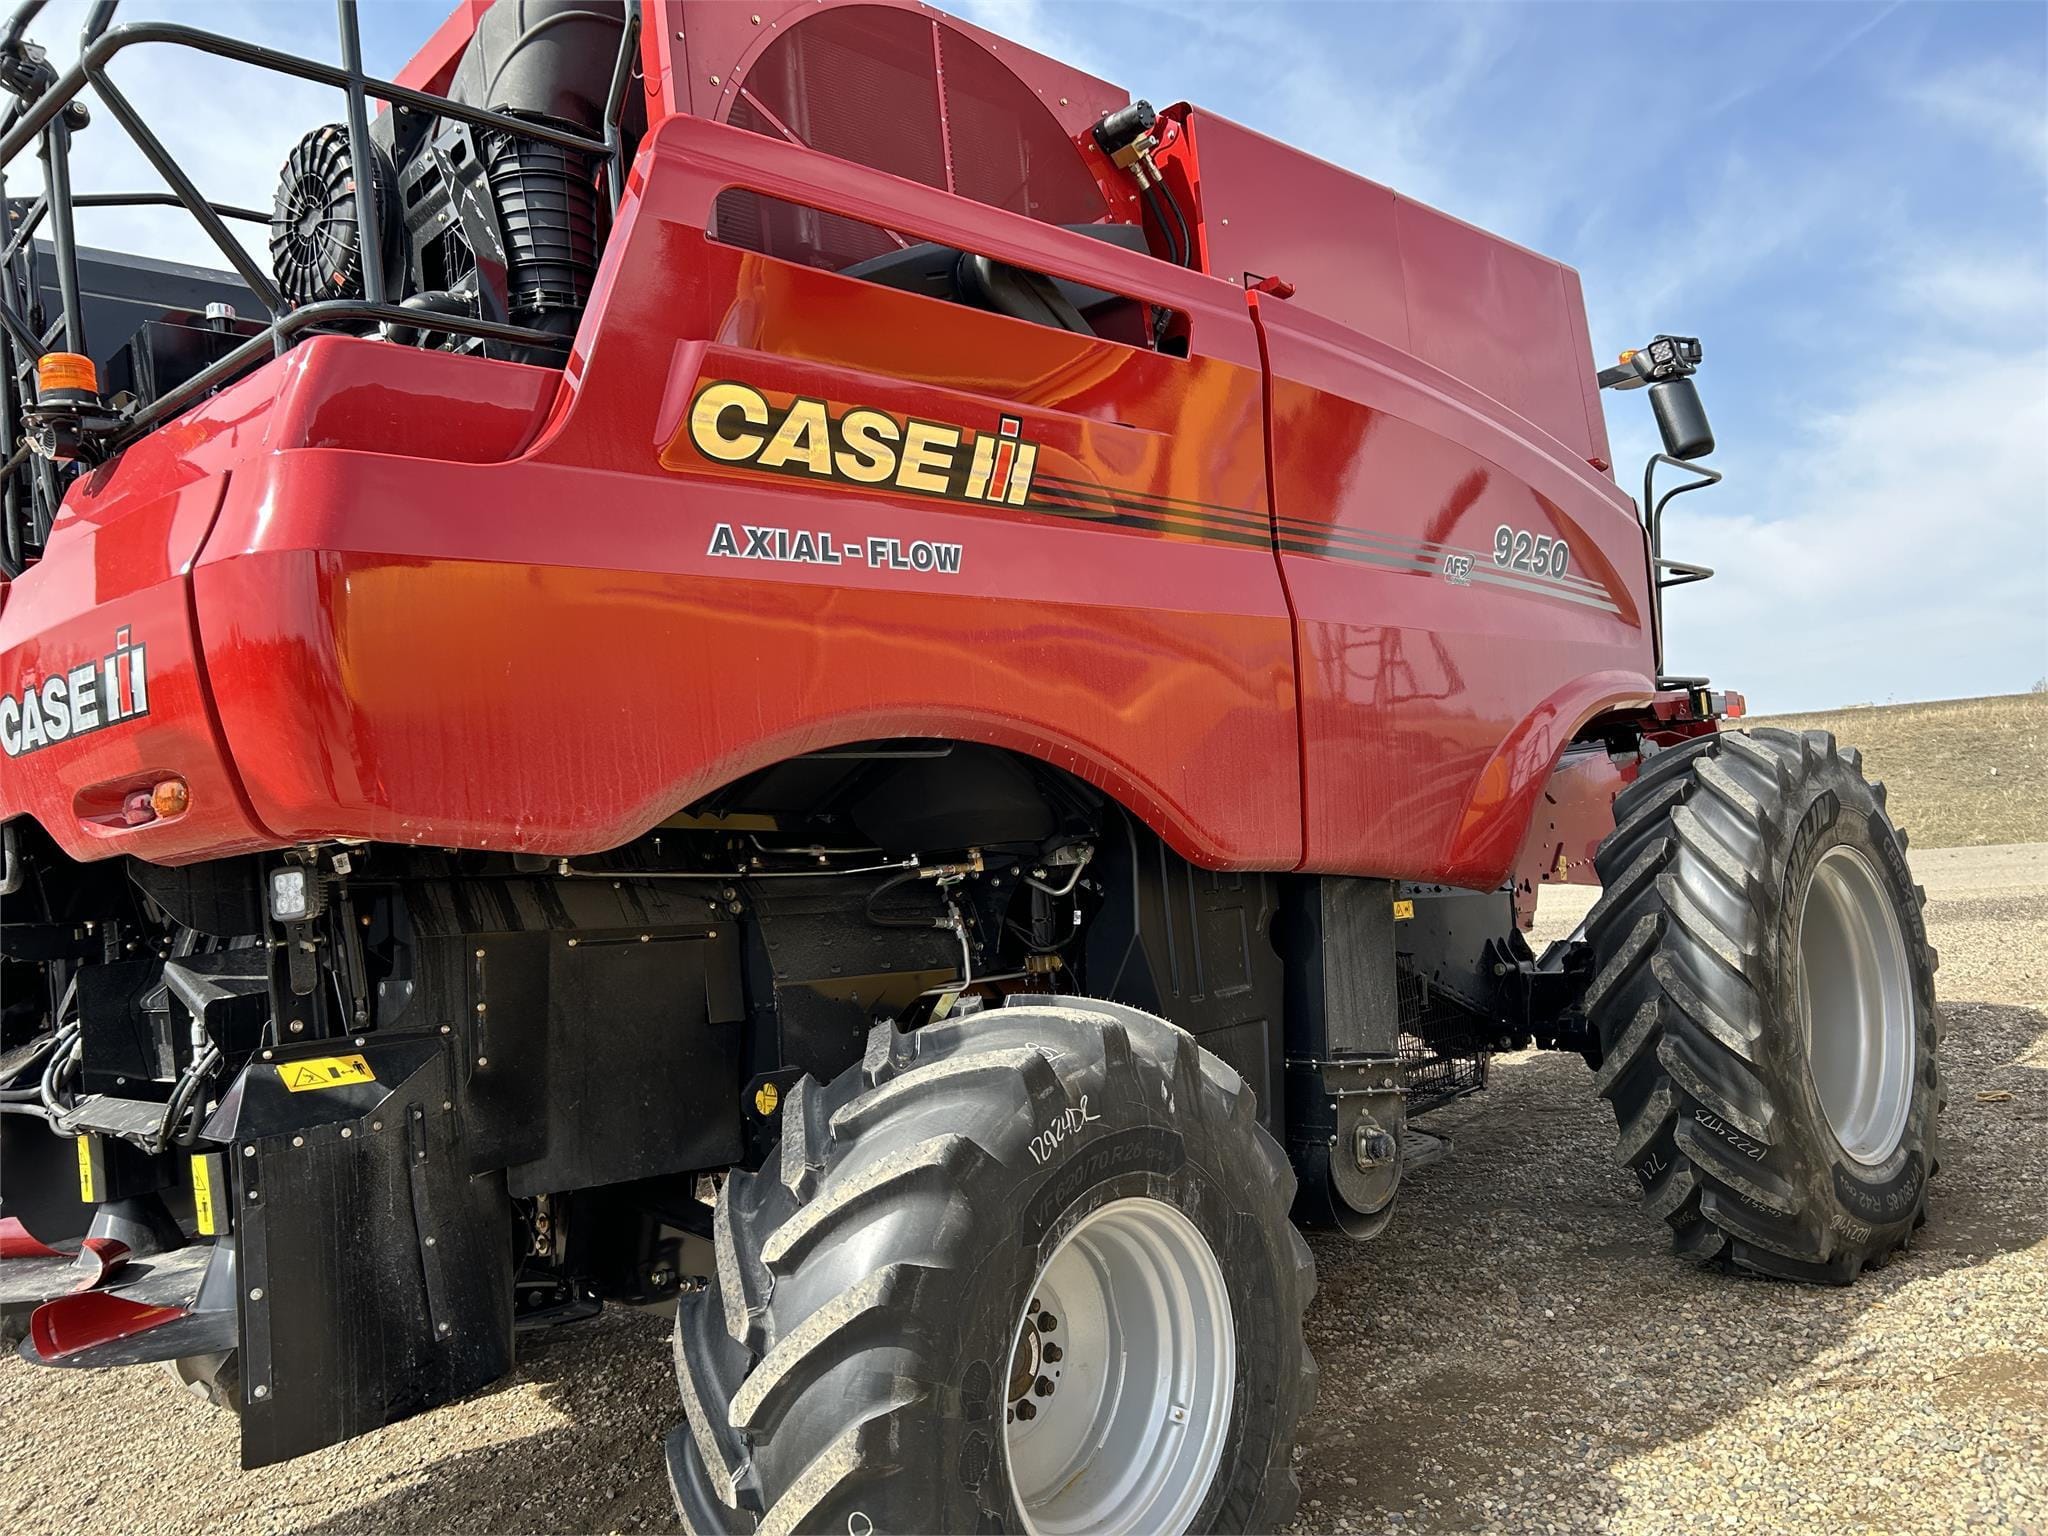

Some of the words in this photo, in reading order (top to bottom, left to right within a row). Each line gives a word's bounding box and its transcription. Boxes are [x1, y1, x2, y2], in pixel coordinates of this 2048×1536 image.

[691, 384, 960, 494] CASE
[707, 522, 963, 573] AXIAL-FLOW
[1444, 555, 1471, 577] AFS
[1494, 524, 1569, 580] 9250
[0, 664, 100, 757] CASE
